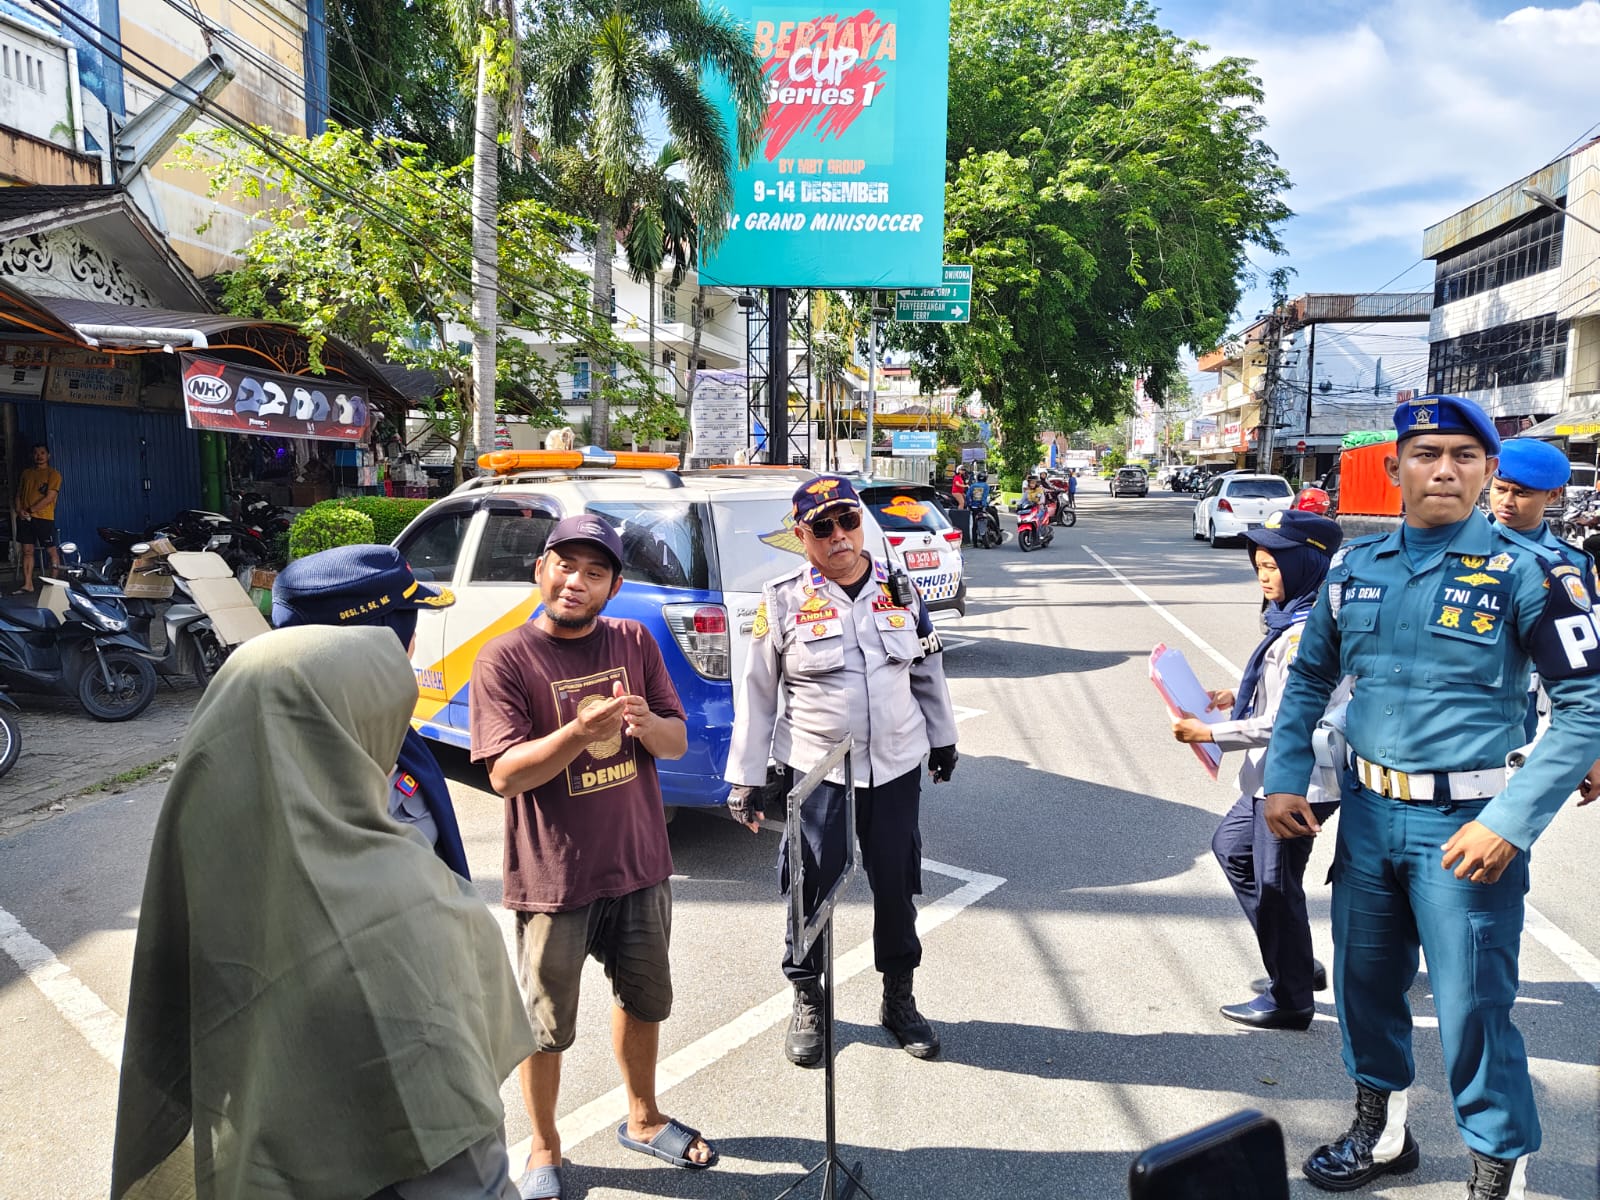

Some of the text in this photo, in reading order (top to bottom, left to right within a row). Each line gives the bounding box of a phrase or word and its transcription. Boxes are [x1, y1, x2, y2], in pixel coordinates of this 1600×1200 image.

[753, 21, 897, 61] BERJAYA
[788, 46, 859, 86] CUP
[761, 79, 877, 107] Series 1
[779, 158, 795, 174] BY
[827, 159, 866, 175] GROUP
[754, 180, 889, 203] 9-14 DESEMBER
[744, 212, 806, 231] GRAND
[809, 212, 924, 233] MINISOCCER
[944, 270, 970, 280] DWIKORA
[899, 302, 946, 311] PENYEBERANGAN
[913, 311, 930, 320] FERRY
[192, 380, 225, 398] NHK
[912, 573, 947, 588] SHUB
[1444, 587, 1500, 611] TNI AL
[919, 630, 943, 659] PA
[1554, 613, 1600, 669] P
[581, 759, 635, 788] DENIM
